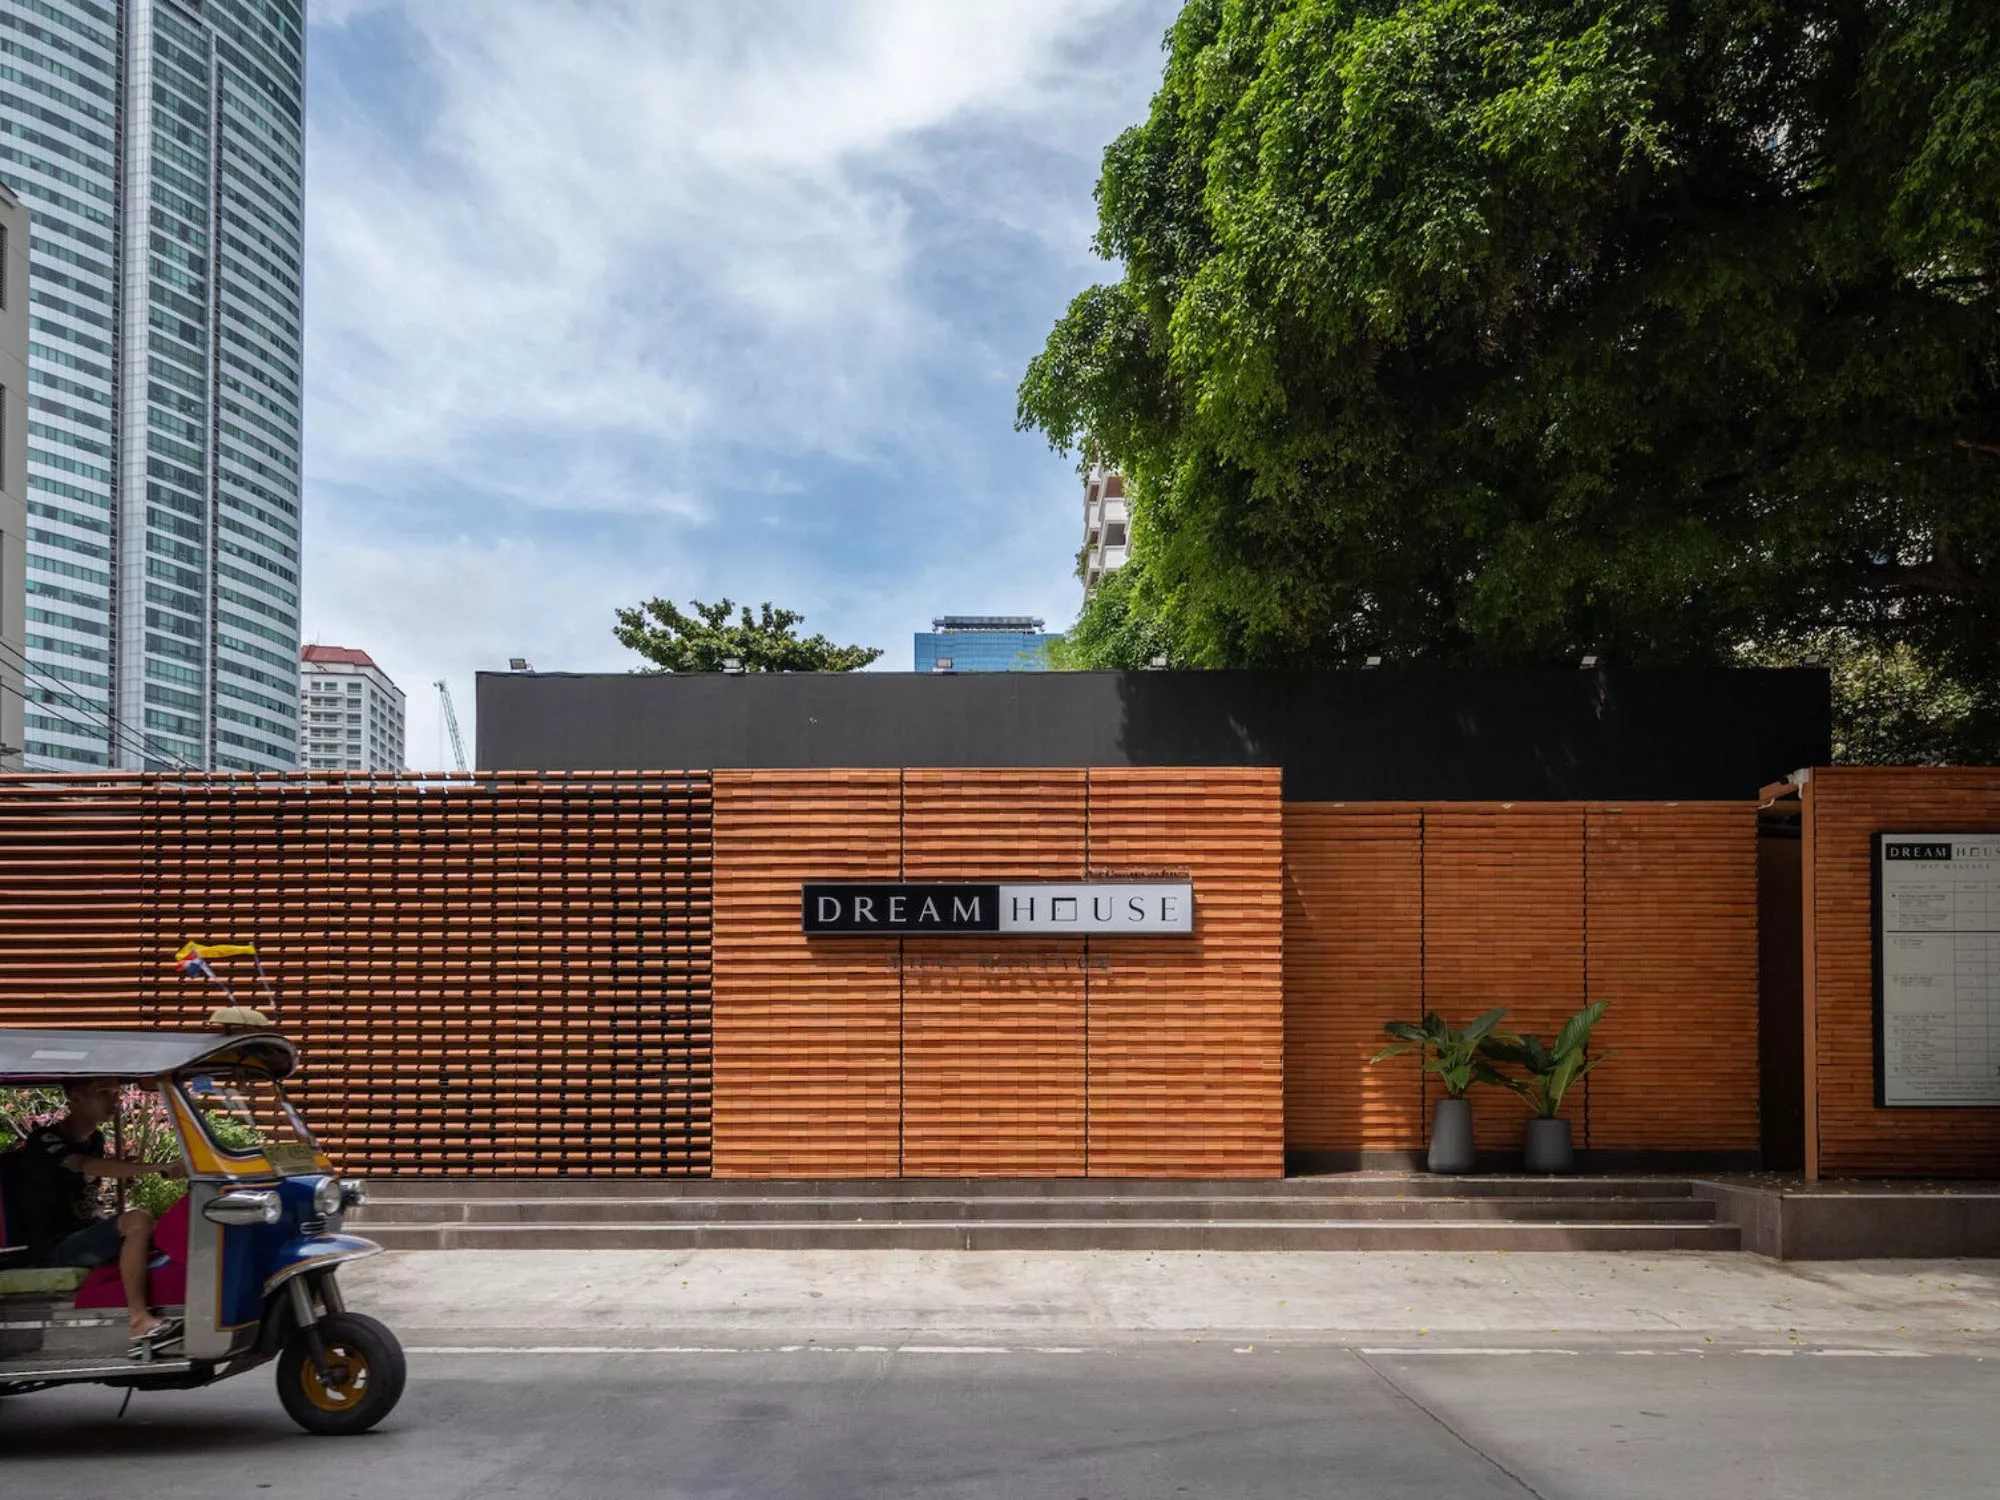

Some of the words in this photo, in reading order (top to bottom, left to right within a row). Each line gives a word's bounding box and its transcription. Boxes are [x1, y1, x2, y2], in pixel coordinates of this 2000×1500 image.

[1890, 847, 1946, 857] DREAM
[817, 896, 982, 922] DREAM
[1013, 896, 1178, 922] HOUSE
